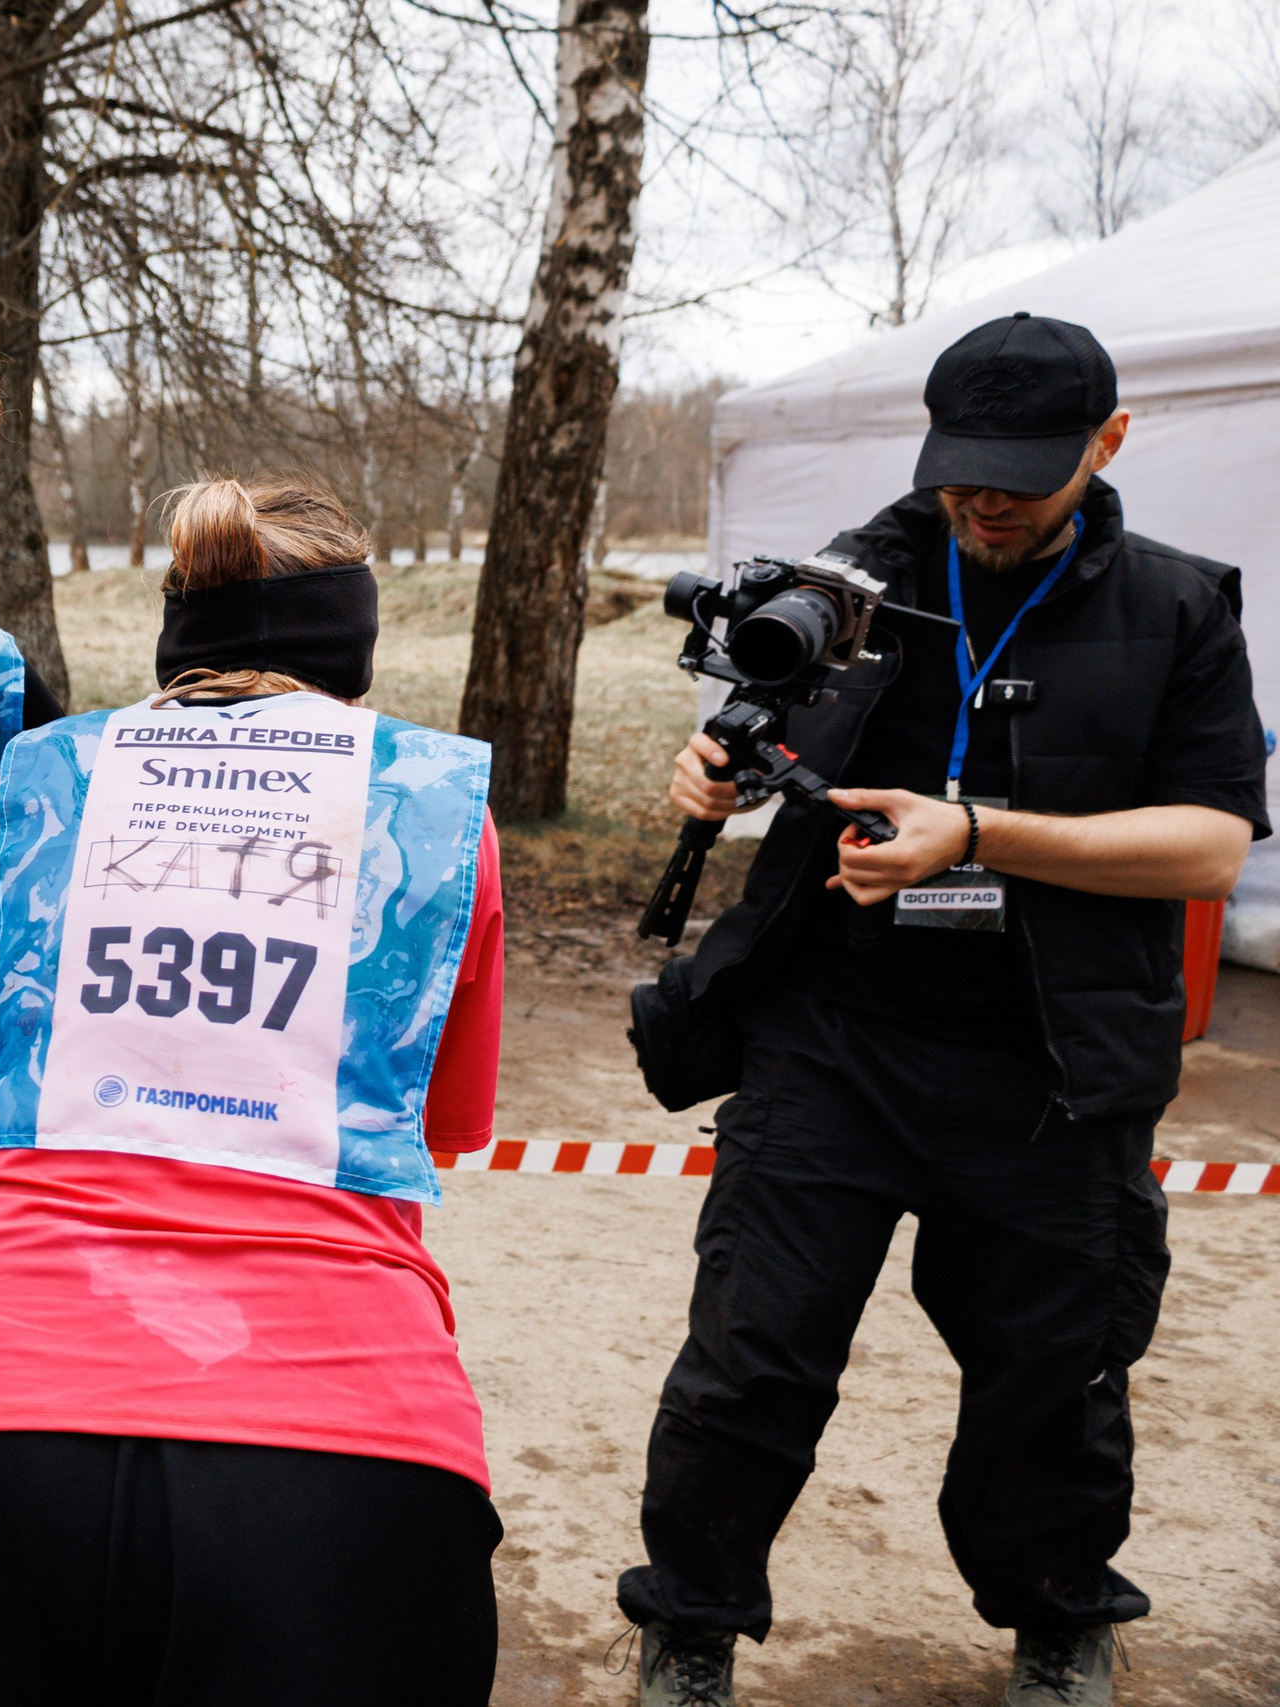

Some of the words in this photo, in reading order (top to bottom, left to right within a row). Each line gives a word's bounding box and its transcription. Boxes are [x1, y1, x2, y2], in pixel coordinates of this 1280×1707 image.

[116, 727, 218, 742] ГОНКА
[230, 727, 355, 748] ГЕРОЕВ
[139, 758, 312, 793] Sminex
[132, 803, 310, 823] ПЕРФЕКЦИОНИСТЫ
[129, 820, 166, 830] FINE
[175, 821, 307, 841] DEVELOPMENT
[102, 833, 336, 919] КАТЯ
[904, 892, 997, 904] ФОТОГРАФ
[80, 926, 318, 1032] 5397
[136, 1086, 279, 1122] ГАЗПРОМБАНК
